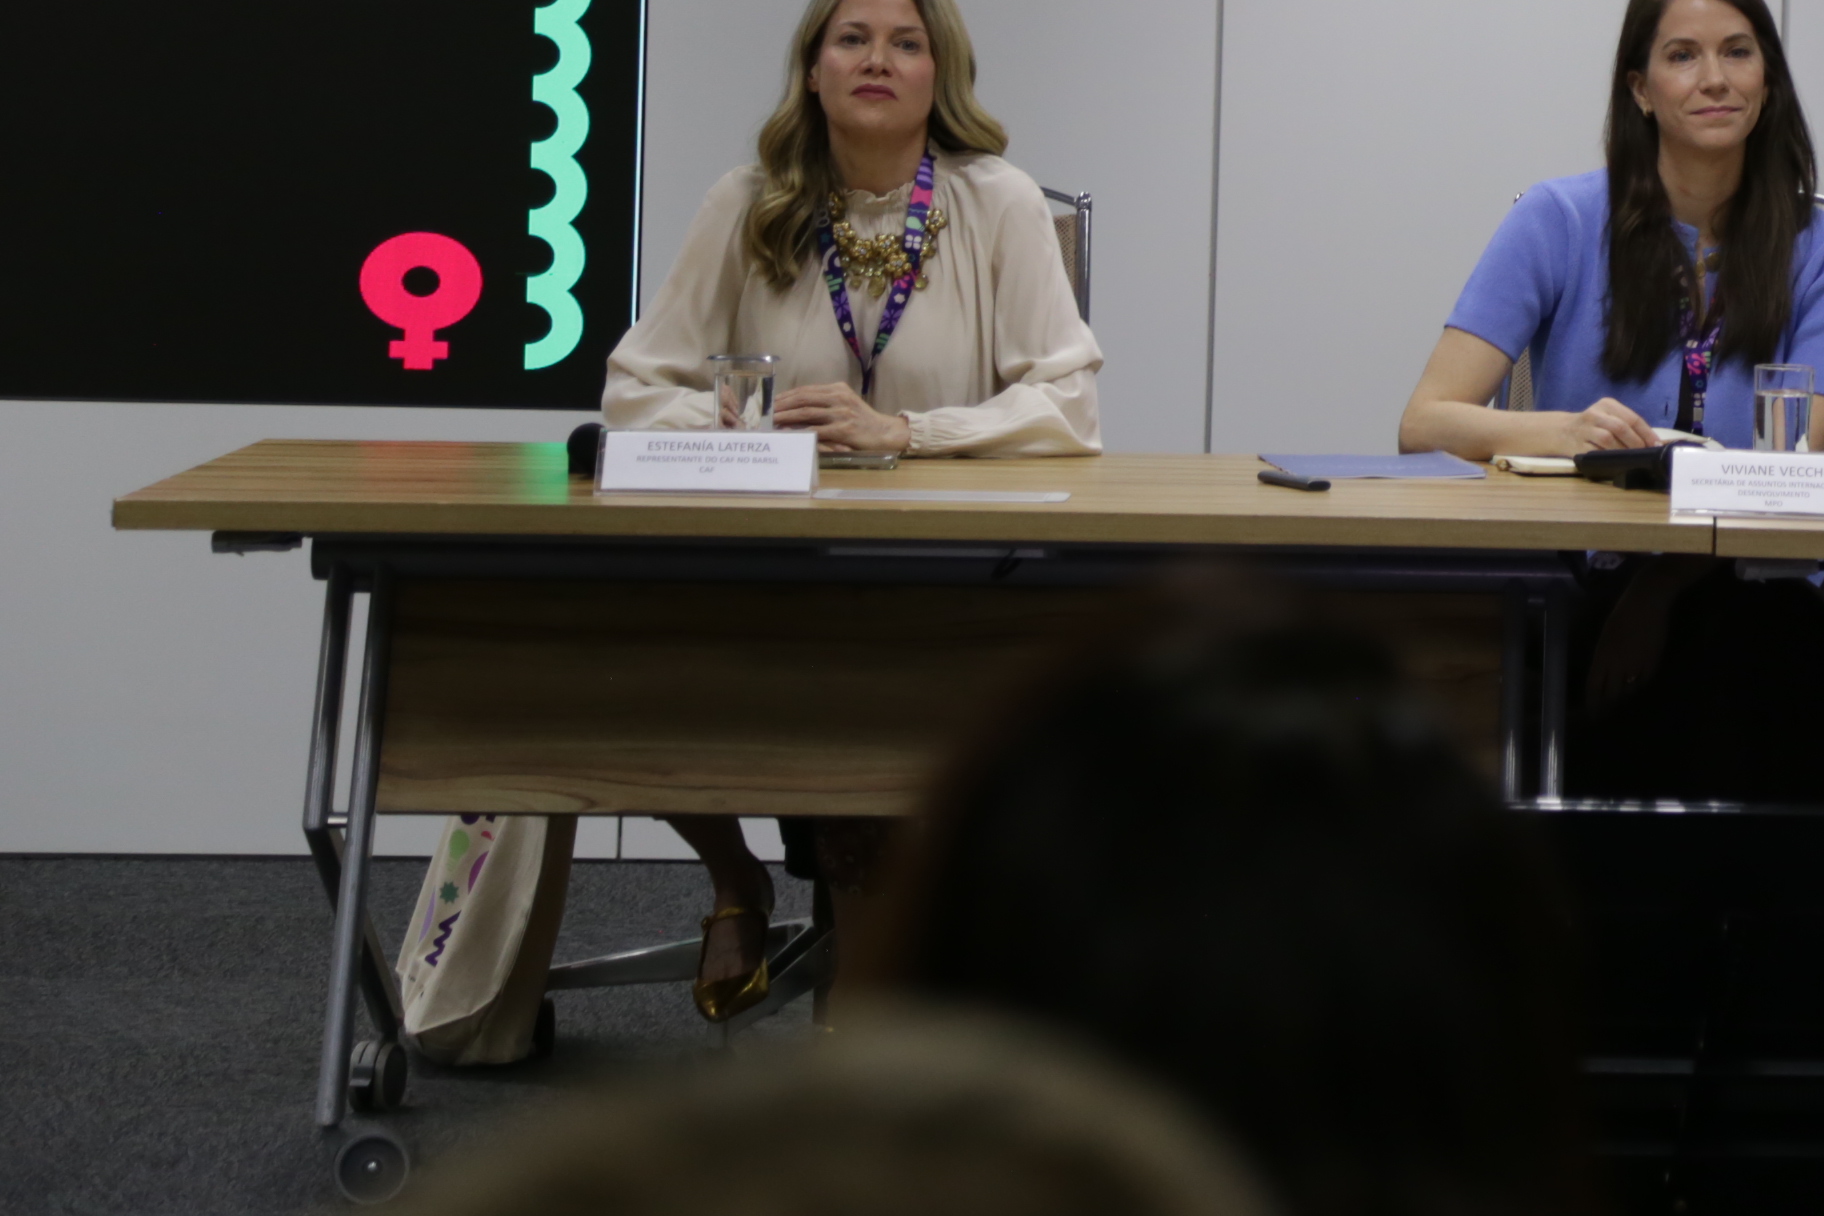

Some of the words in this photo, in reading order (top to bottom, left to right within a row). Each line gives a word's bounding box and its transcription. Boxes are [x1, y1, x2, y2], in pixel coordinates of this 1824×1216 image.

[647, 440, 714, 452] ESTEFANÍA
[718, 442, 770, 452] LATERZA
[636, 455, 702, 463] REPRESENTANTE
[1721, 464, 1775, 476] VIVIANE
[1691, 478, 1734, 486] SECRETÁRIA
[1738, 489, 1810, 498] DESENVOLVIMENTO
